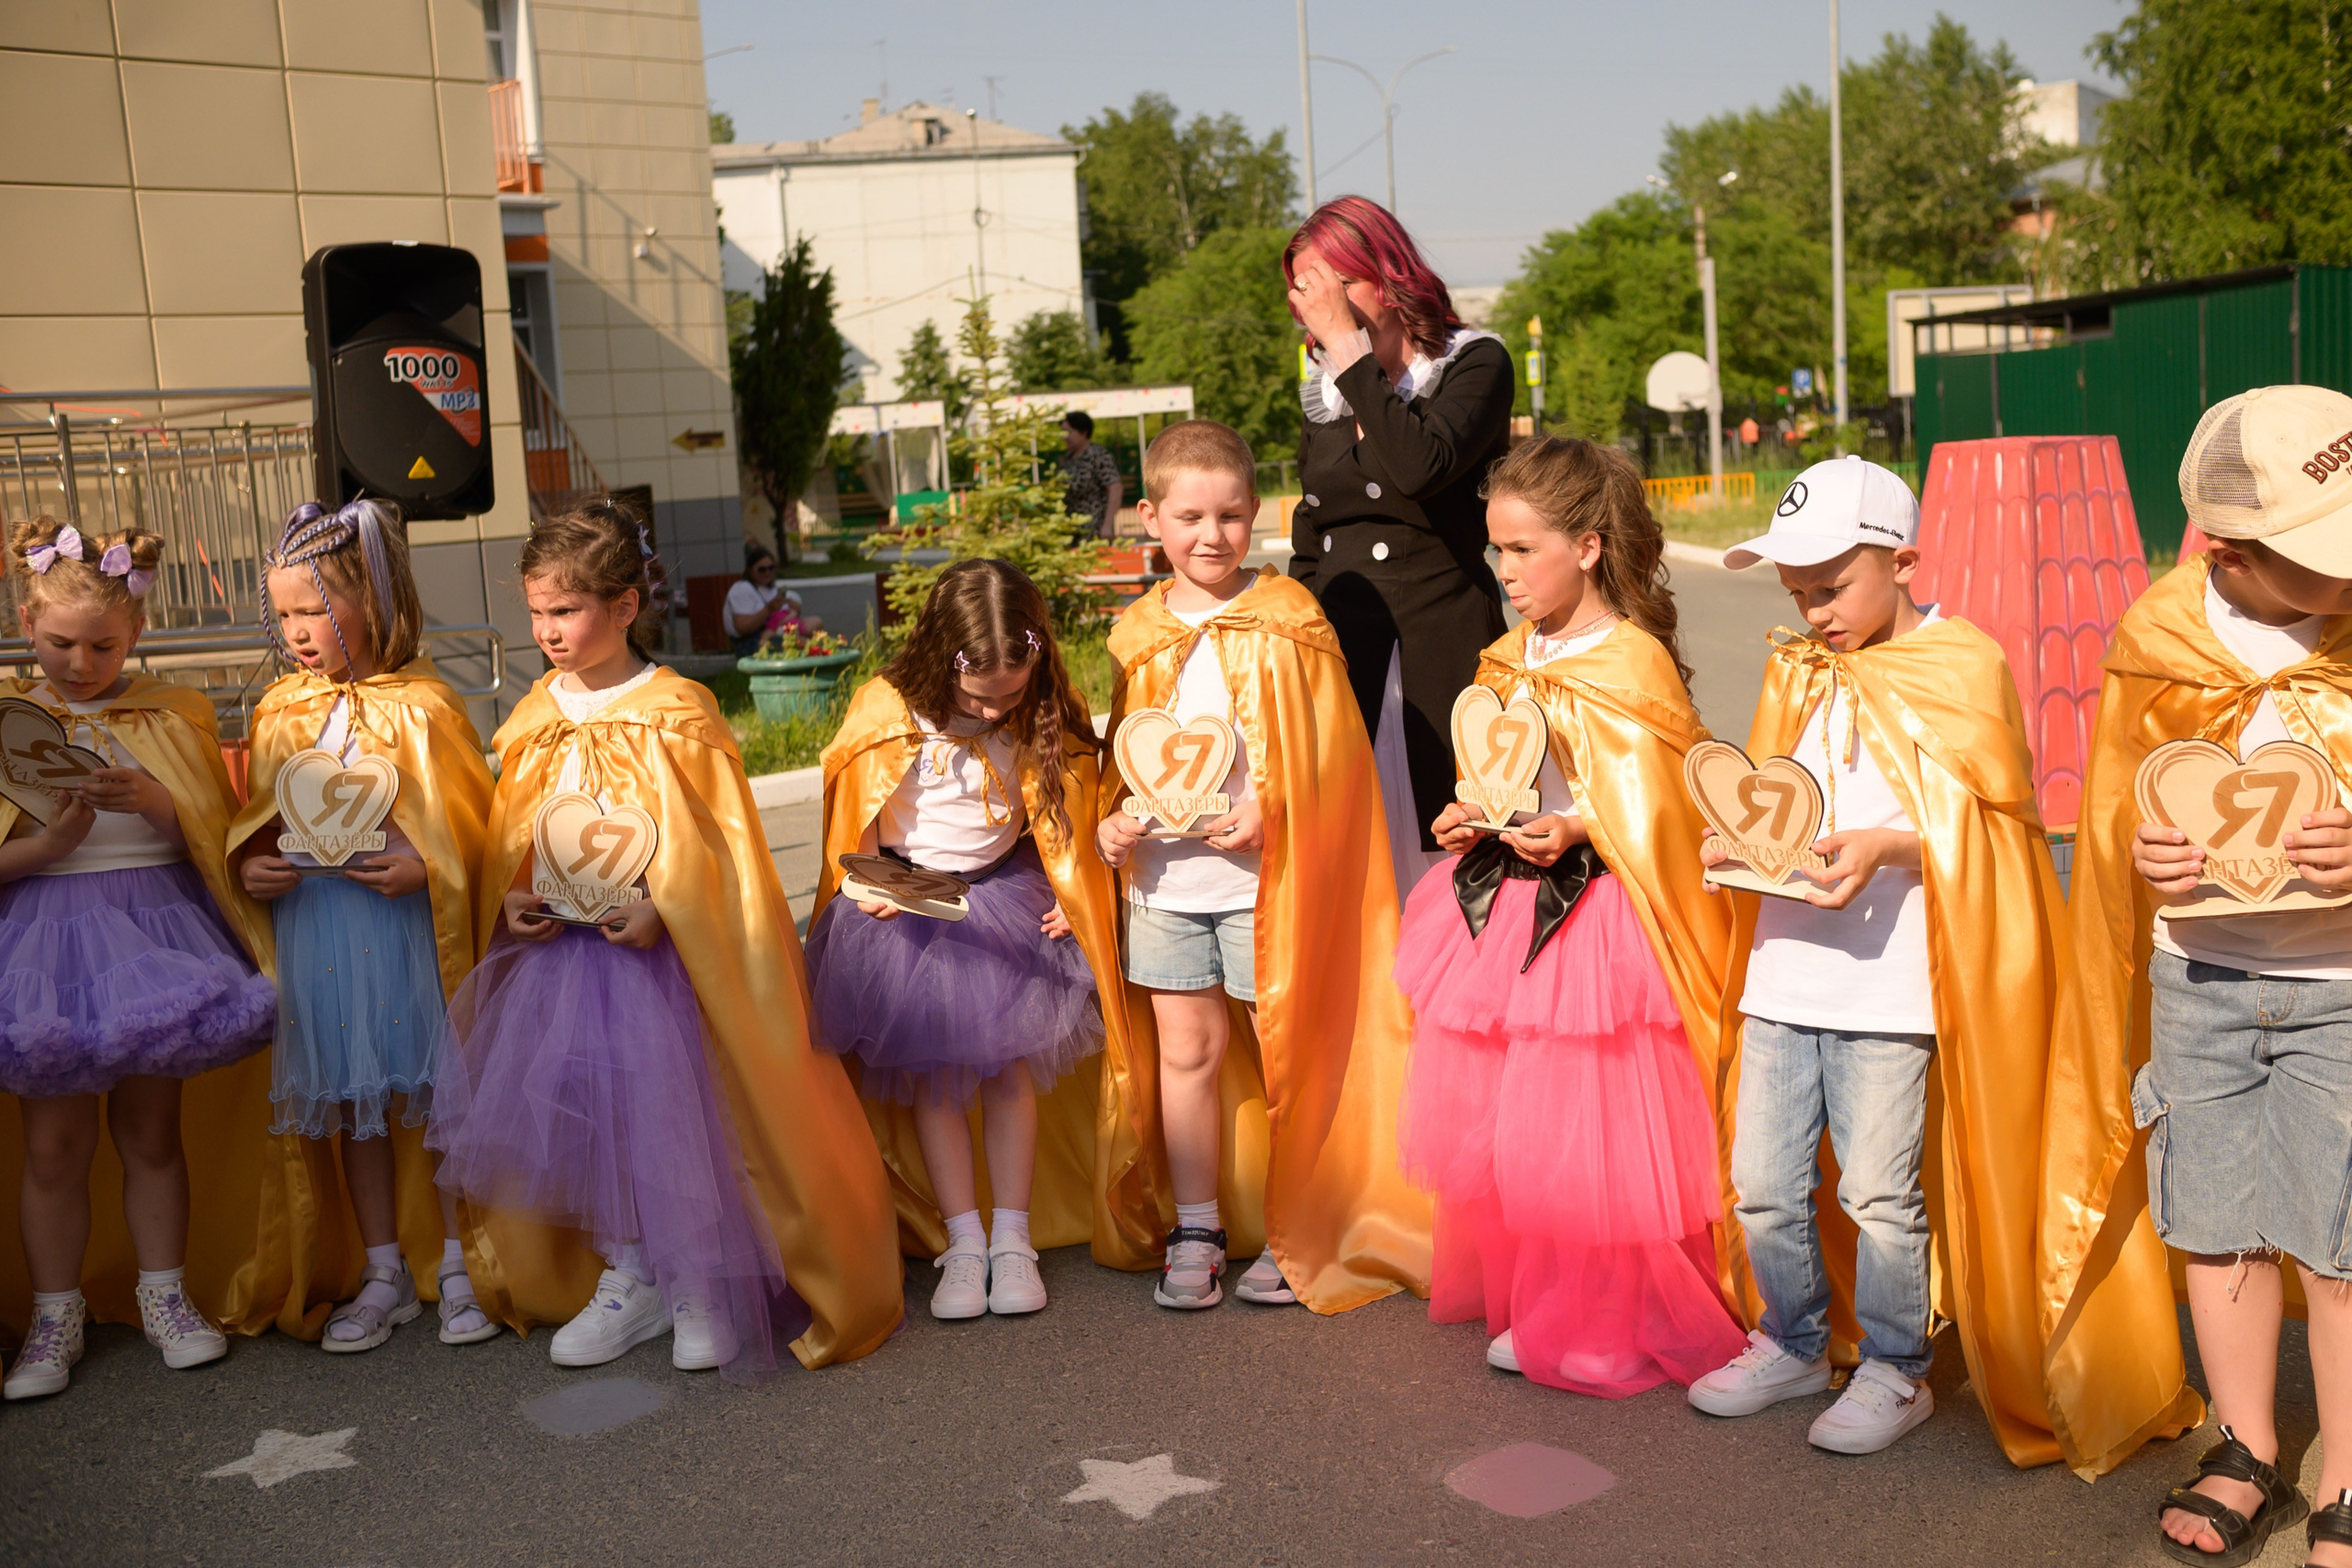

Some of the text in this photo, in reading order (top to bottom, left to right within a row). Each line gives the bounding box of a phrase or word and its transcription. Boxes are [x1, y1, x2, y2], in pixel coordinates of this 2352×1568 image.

[385, 355, 460, 380] 1000
[441, 392, 475, 409] MP3
[2301, 431, 2352, 485] BOST
[1153, 731, 1216, 791] Я
[1479, 715, 1530, 782] Я
[311, 772, 379, 828] Я
[1125, 795, 1227, 814] ФАНТАЗЁРЫ
[1736, 774, 1796, 841] Я
[2207, 769, 2301, 850] Я
[280, 832, 384, 850] ФАНТАЗЁРЫ
[567, 819, 636, 880] Я
